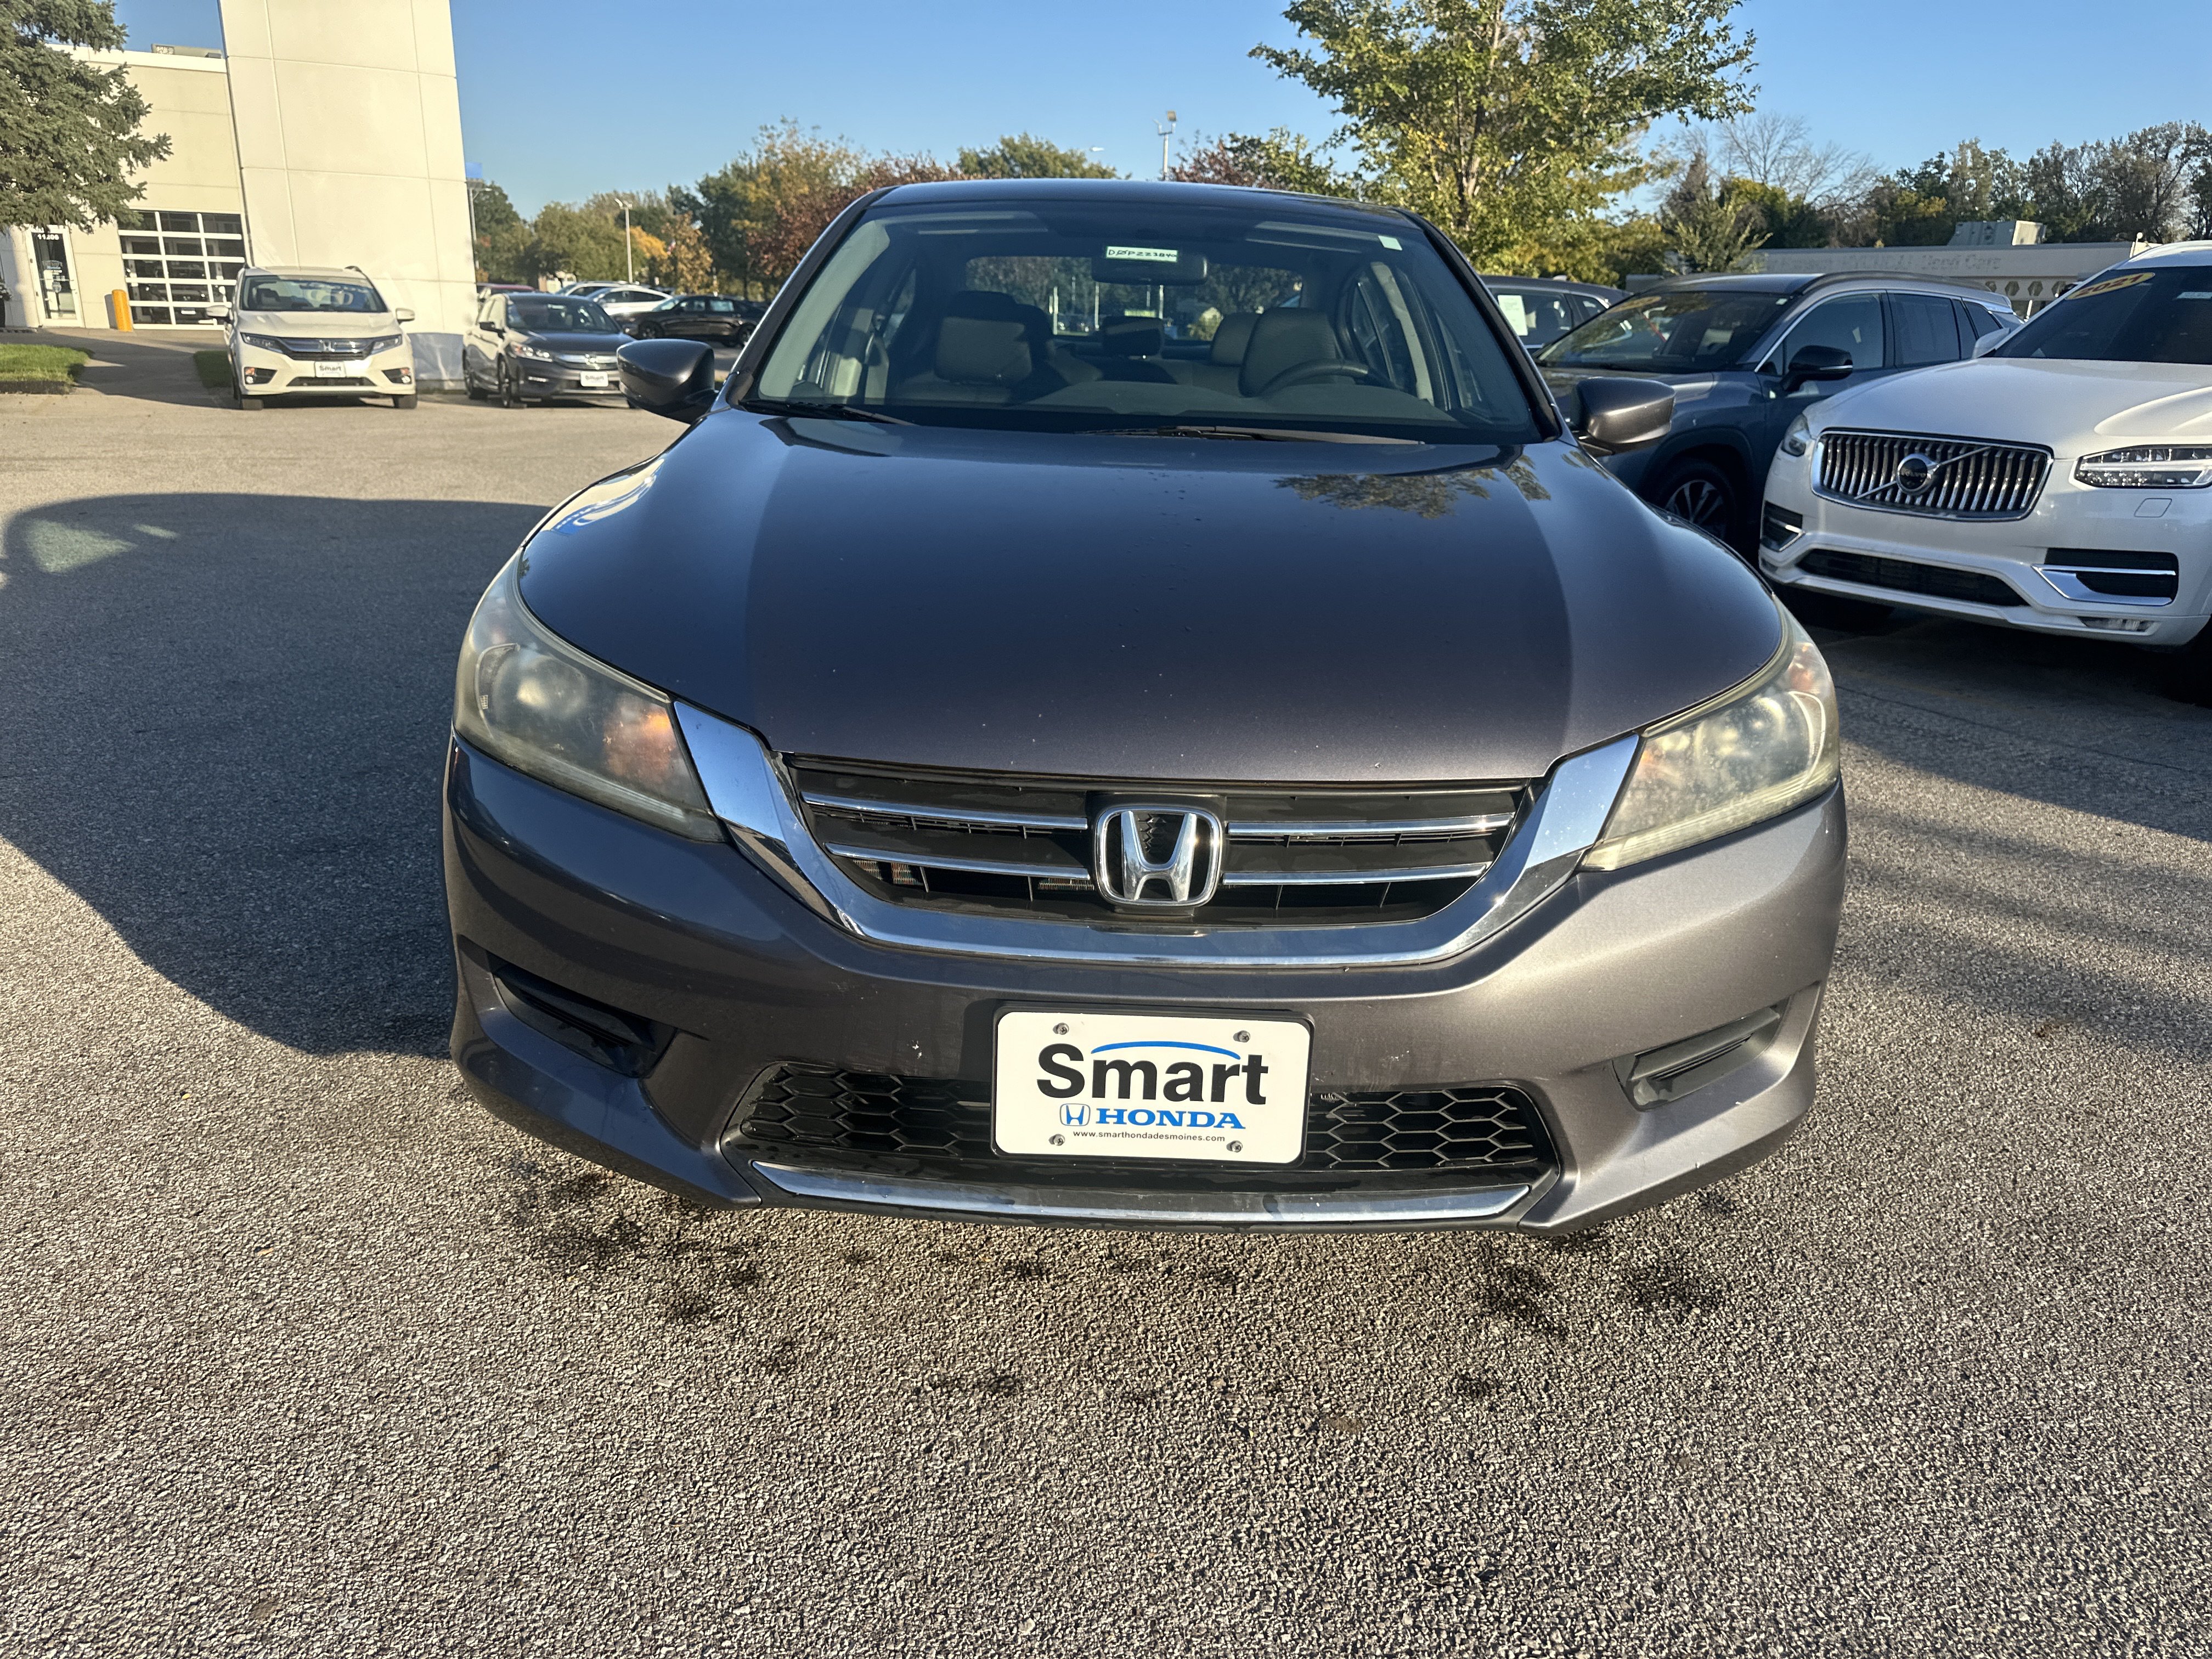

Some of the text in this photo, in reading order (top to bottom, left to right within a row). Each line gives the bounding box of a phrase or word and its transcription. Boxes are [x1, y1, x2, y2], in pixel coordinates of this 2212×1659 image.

[2074, 275, 2143, 297] 2021
[1036, 1043, 1269, 1104] Smart
[1096, 1108, 1246, 1129] HONDA
[1073, 1130, 1226, 1142] www.smarthondadesmoines.com
